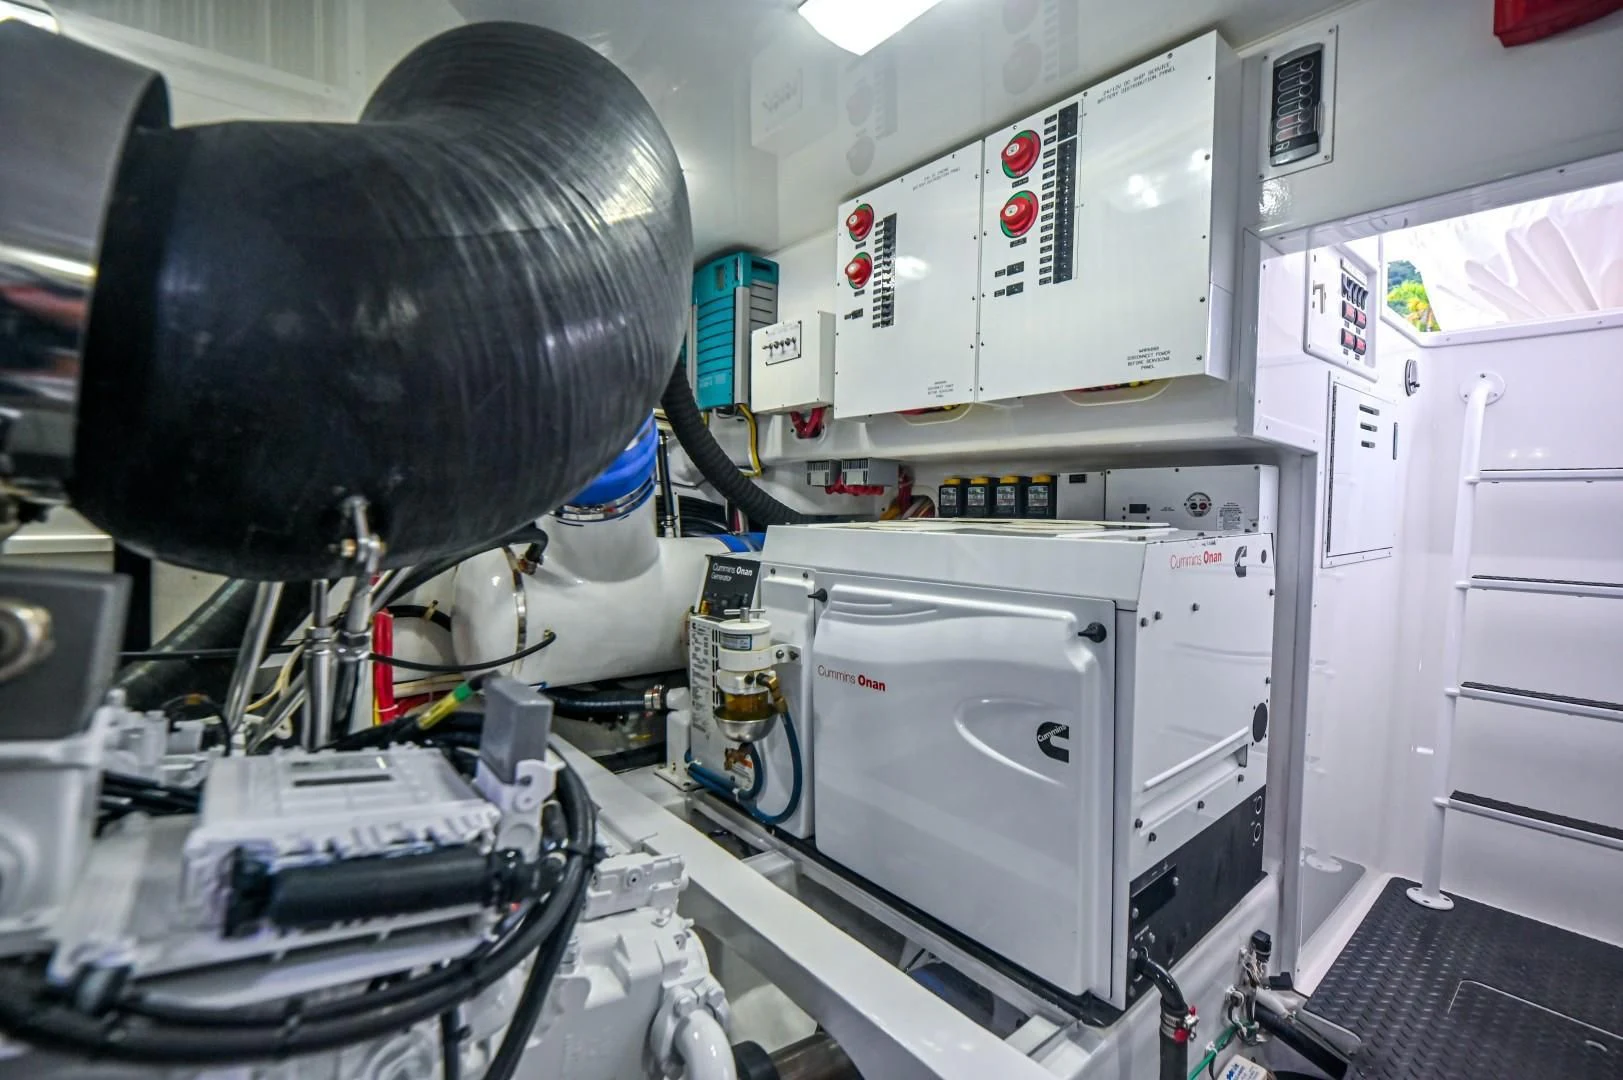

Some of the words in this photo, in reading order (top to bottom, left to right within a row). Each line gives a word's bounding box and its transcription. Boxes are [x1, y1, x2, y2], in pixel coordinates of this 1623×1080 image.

[1169, 553, 1202, 570] Cummins
[1203, 550, 1222, 565] Onan
[712, 562, 736, 574] Cummins
[736, 566, 753, 577] Onan
[817, 664, 856, 685] Cummins
[857, 674, 886, 692] Onan
[1037, 725, 1067, 742] Cummins
